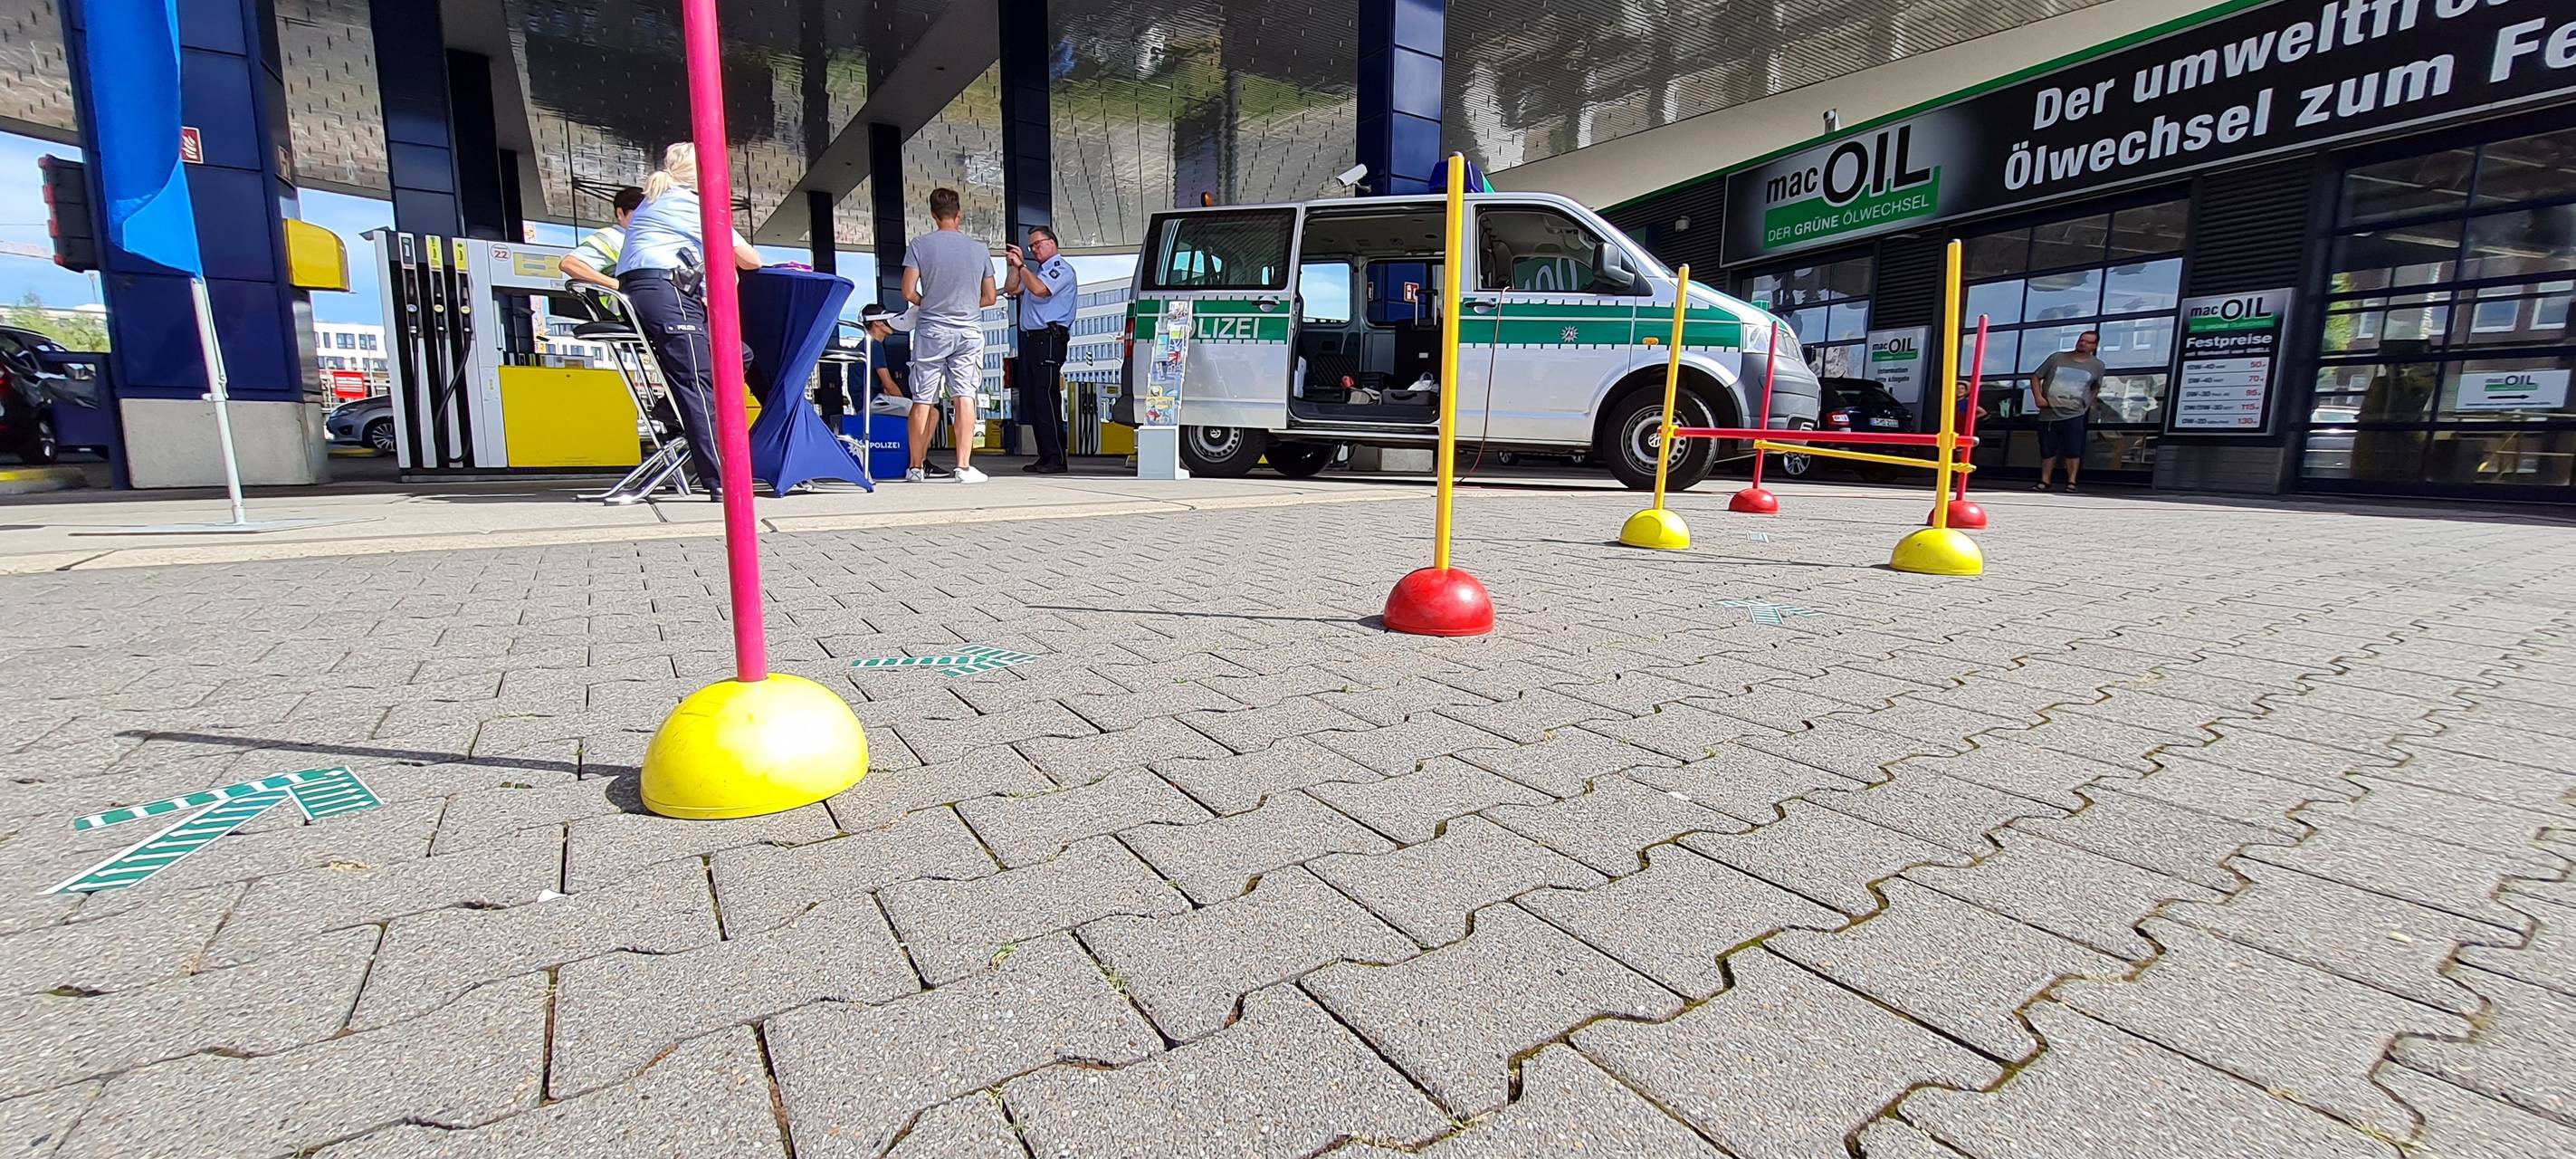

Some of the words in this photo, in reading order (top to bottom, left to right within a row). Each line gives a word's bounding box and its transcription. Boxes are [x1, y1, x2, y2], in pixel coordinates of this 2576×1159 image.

[2033, 78, 2115, 130] Der
[2132, 0, 2513, 103] umweltfr
[2004, 87, 2274, 190] Ölwechsel
[2295, 53, 2455, 128] zum
[1823, 124, 1931, 204] OIL
[1768, 226, 1791, 242] DER
[1794, 215, 1839, 235] GRÜNE
[1843, 195, 1930, 225] ÖLWECHSEL
[494, 250, 508, 259] 22
[2220, 296, 2273, 321] OIL
[1188, 317, 1260, 340] LIZEI
[2185, 332, 2274, 349] Festpreise
[869, 441, 901, 450] POLIZEI
